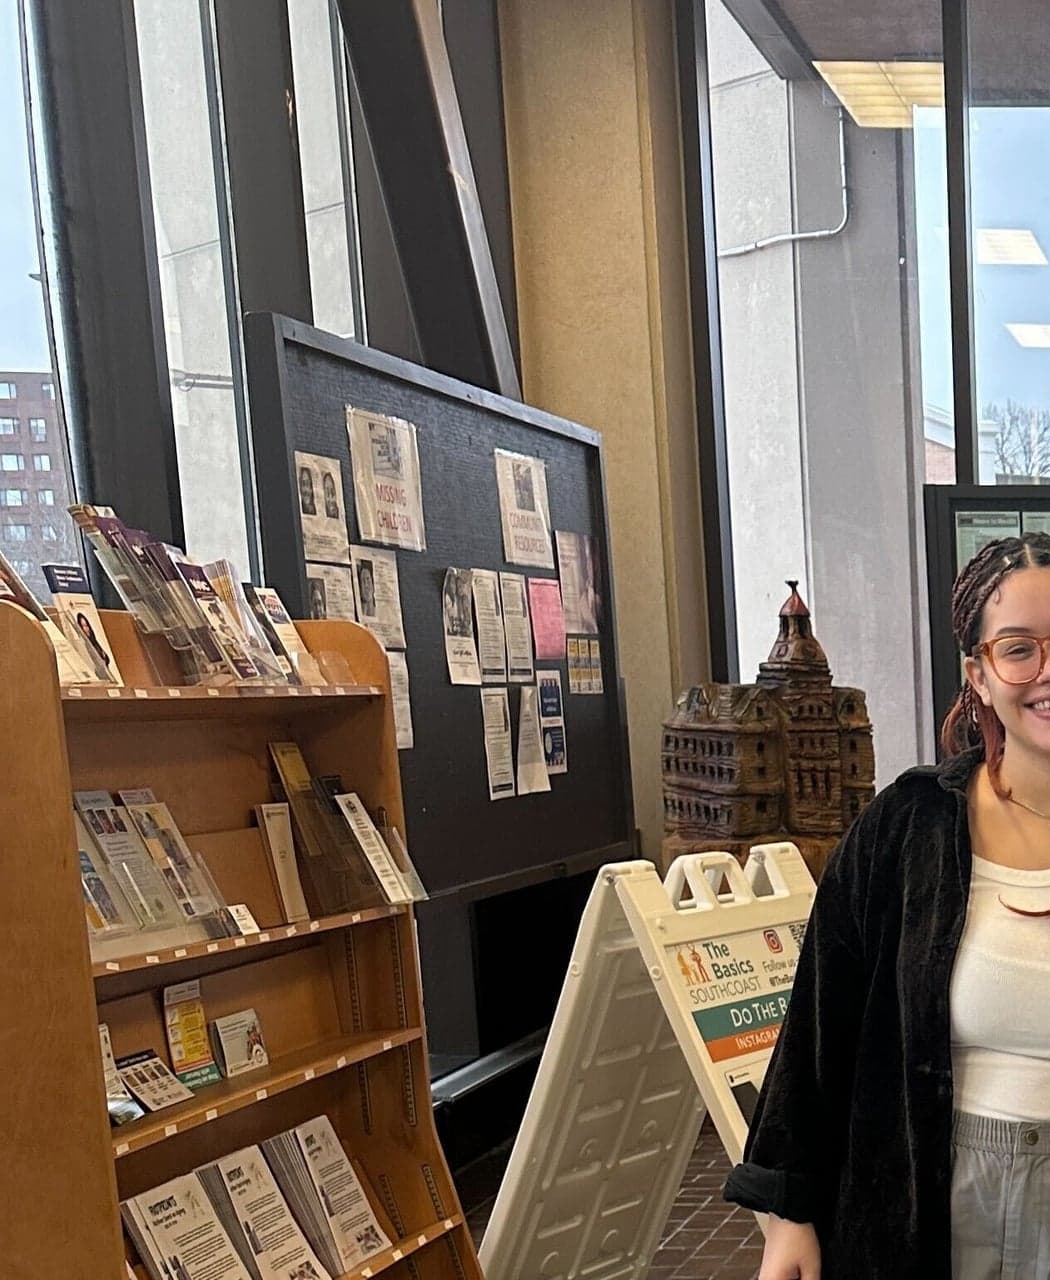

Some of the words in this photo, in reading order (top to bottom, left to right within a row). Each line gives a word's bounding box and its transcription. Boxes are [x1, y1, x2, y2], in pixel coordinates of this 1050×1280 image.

[376, 483, 407, 506] MISSING
[703, 942, 730, 960] The
[712, 958, 754, 980] Basics
[762, 959, 786, 973] Follow
[690, 976, 762, 1005] SOUTHCOAST
[730, 1007, 753, 1027] DO
[753, 1001, 778, 1021] THE
[735, 1028, 780, 1049] INSTAGRA
